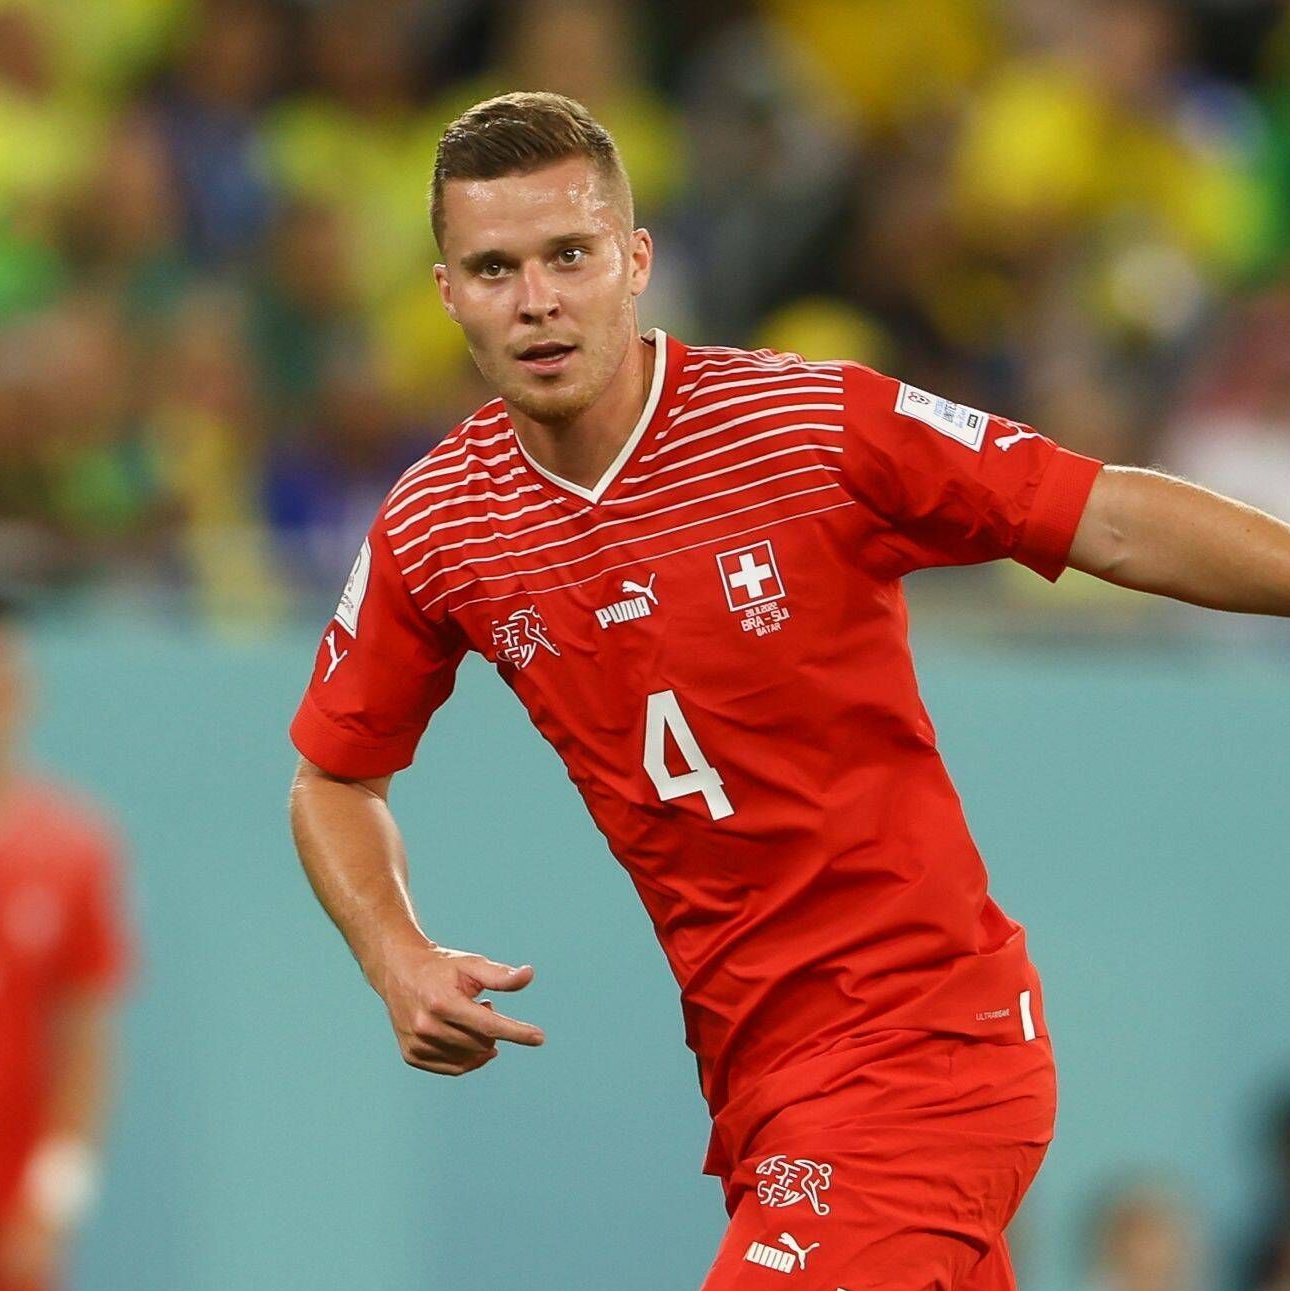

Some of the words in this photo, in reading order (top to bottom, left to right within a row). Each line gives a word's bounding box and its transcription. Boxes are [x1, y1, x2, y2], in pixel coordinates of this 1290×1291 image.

[595, 596, 652, 629] PUMA
[741, 615, 765, 632] BRA
[771, 607, 790, 622] SUI
[756, 622, 782, 637] QATAR
[643, 689, 735, 821] 4
[743, 1241, 796, 1274] UMA
